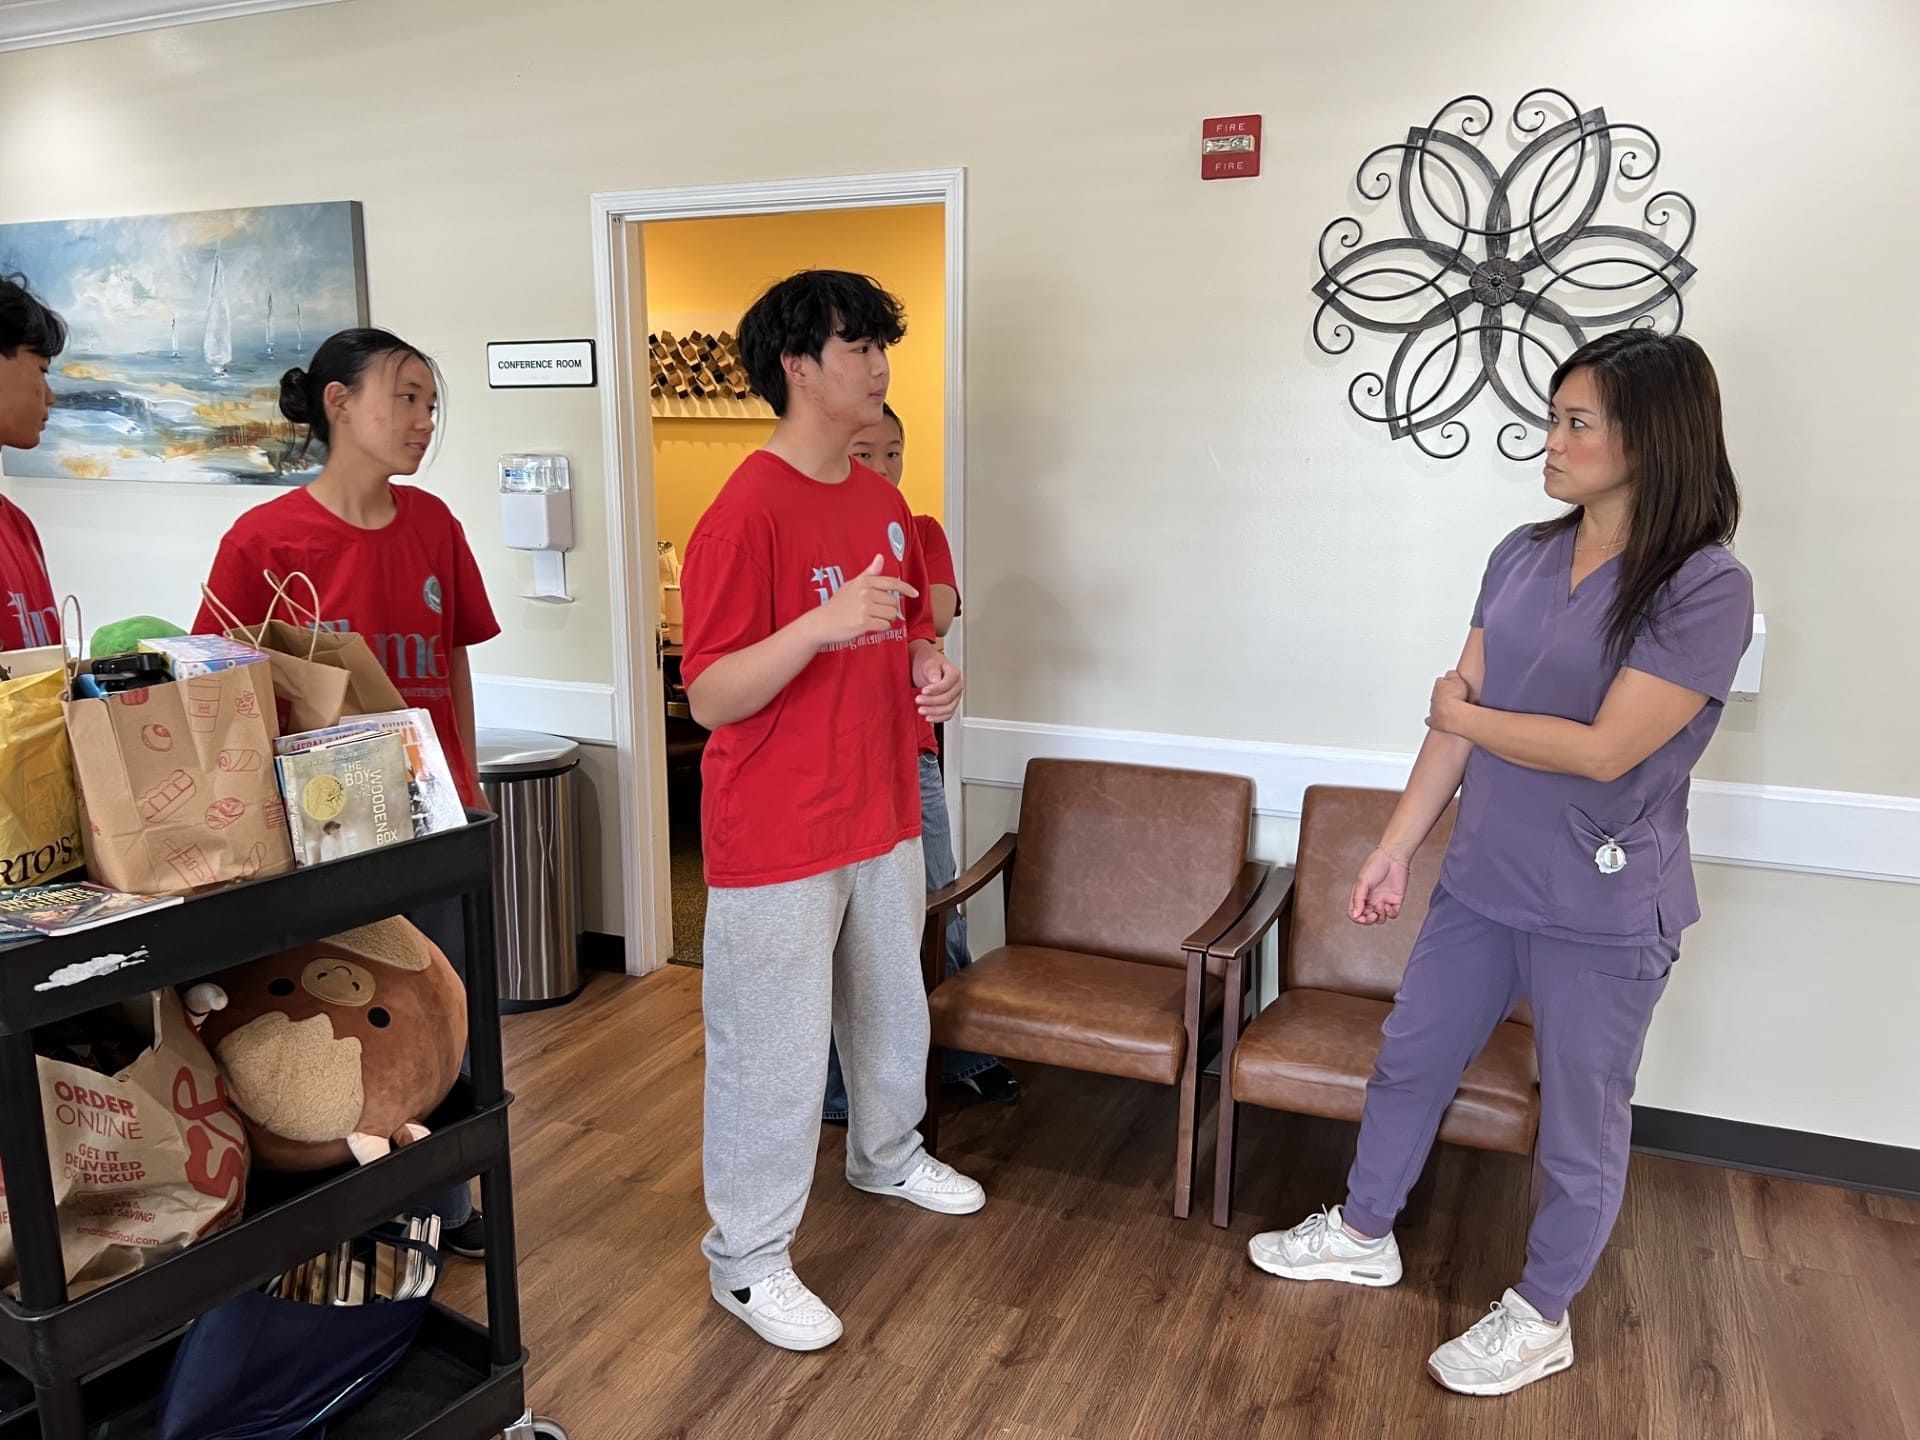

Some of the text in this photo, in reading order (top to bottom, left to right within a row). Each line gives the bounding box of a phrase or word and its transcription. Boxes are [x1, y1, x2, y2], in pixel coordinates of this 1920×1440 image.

[1216, 122, 1246, 133] FIRE
[1215, 161, 1244, 171] FIRE
[498, 359, 582, 370] CONFERENCE ROOM
[342, 760, 361, 773] THE
[345, 769, 370, 787] BOY
[370, 769, 388, 833] WOODEN
[376, 829, 398, 845] BOX
[54, 1080, 136, 1118] ORDER
[56, 1104, 144, 1140] ONLINE
[79, 1143, 119, 1161] GET IT
[65, 1152, 142, 1173] DELIVERED
[83, 1170, 146, 1185] PICKUP
[118, 1208, 156, 1223] SAVING!
